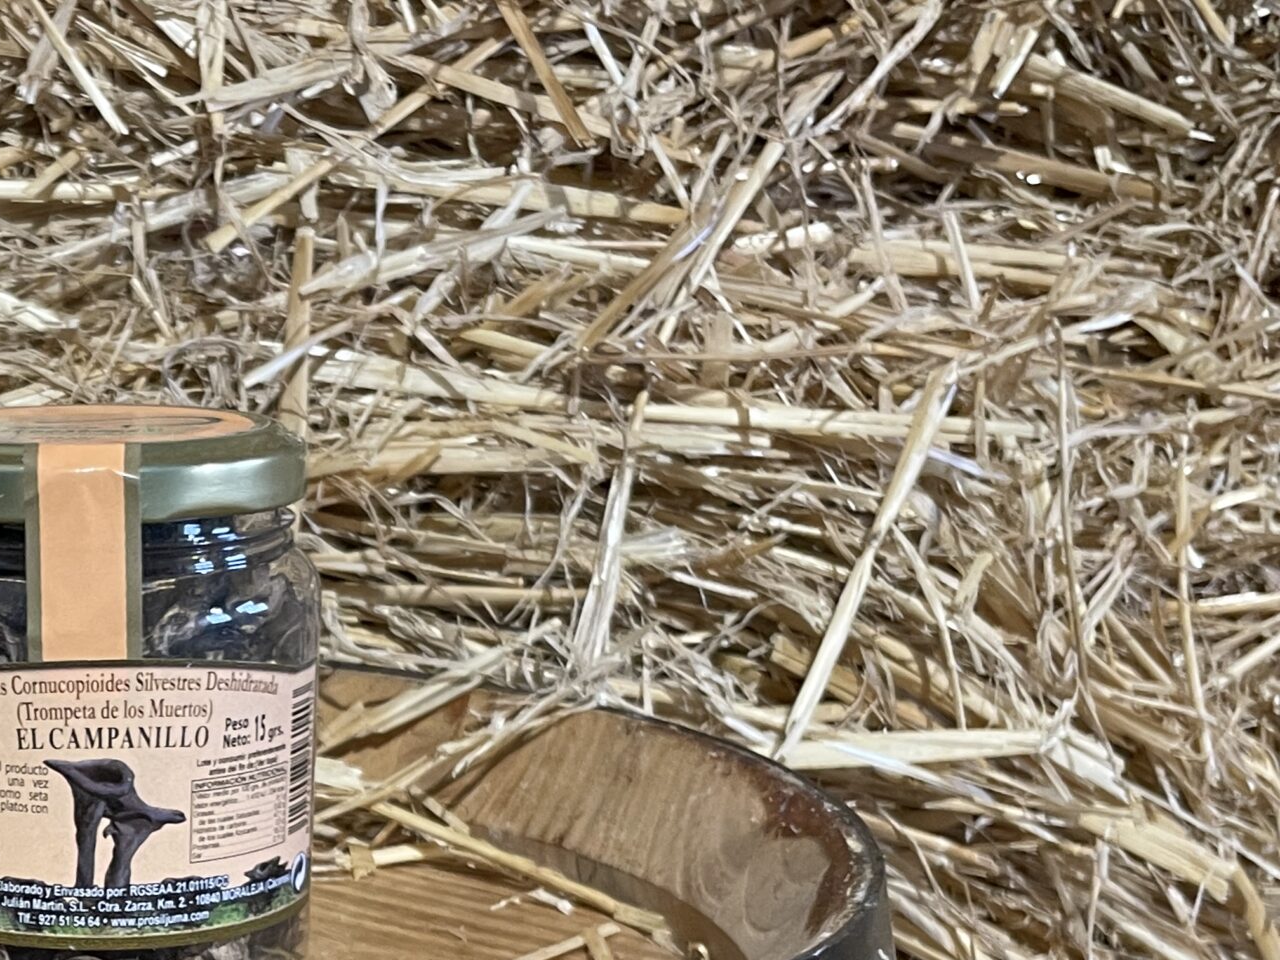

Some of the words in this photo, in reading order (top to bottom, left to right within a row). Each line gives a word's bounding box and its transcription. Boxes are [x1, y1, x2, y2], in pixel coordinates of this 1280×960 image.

[11, 672, 130, 699] Cornucopioides
[135, 672, 201, 692] Silvestres
[205, 671, 279, 695] Deshidratada
[16, 701, 96, 726] (Trompeta
[101, 701, 119, 719] de
[124, 700, 144, 719] los
[149, 699, 213, 723] Muertos)
[225, 717, 249, 731] Peso
[255, 714, 266, 742] 15
[268, 725, 284, 743] grs.
[16, 727, 44, 750] EL
[49, 725, 210, 750] CAMPANILLO
[223, 734, 251, 749] Neto:
[5, 763, 49, 777] producto
[7, 777, 25, 787] una
[32, 779, 49, 789] vez
[28, 790, 48, 801] seta
[0, 800, 29, 813] platos
[30, 804, 48, 814] con
[1, 896, 30, 910] Julián
[69, 901, 89, 912] S.L.
[97, 900, 121, 912] Ctra.
[157, 898, 176, 910] Km.
[195, 893, 220, 905] 10840
[222, 881, 264, 901] MORALEJA
[45, 887, 51, 898] y
[54, 886, 104, 898] Envasado
[106, 888, 127, 899] por:
[38, 914, 55, 926] 927
[59, 915, 70, 926] 51
[73, 916, 86, 927] 54
[87, 916, 100, 928] 64
[111, 911, 210, 929] www.prosiljuma.com
